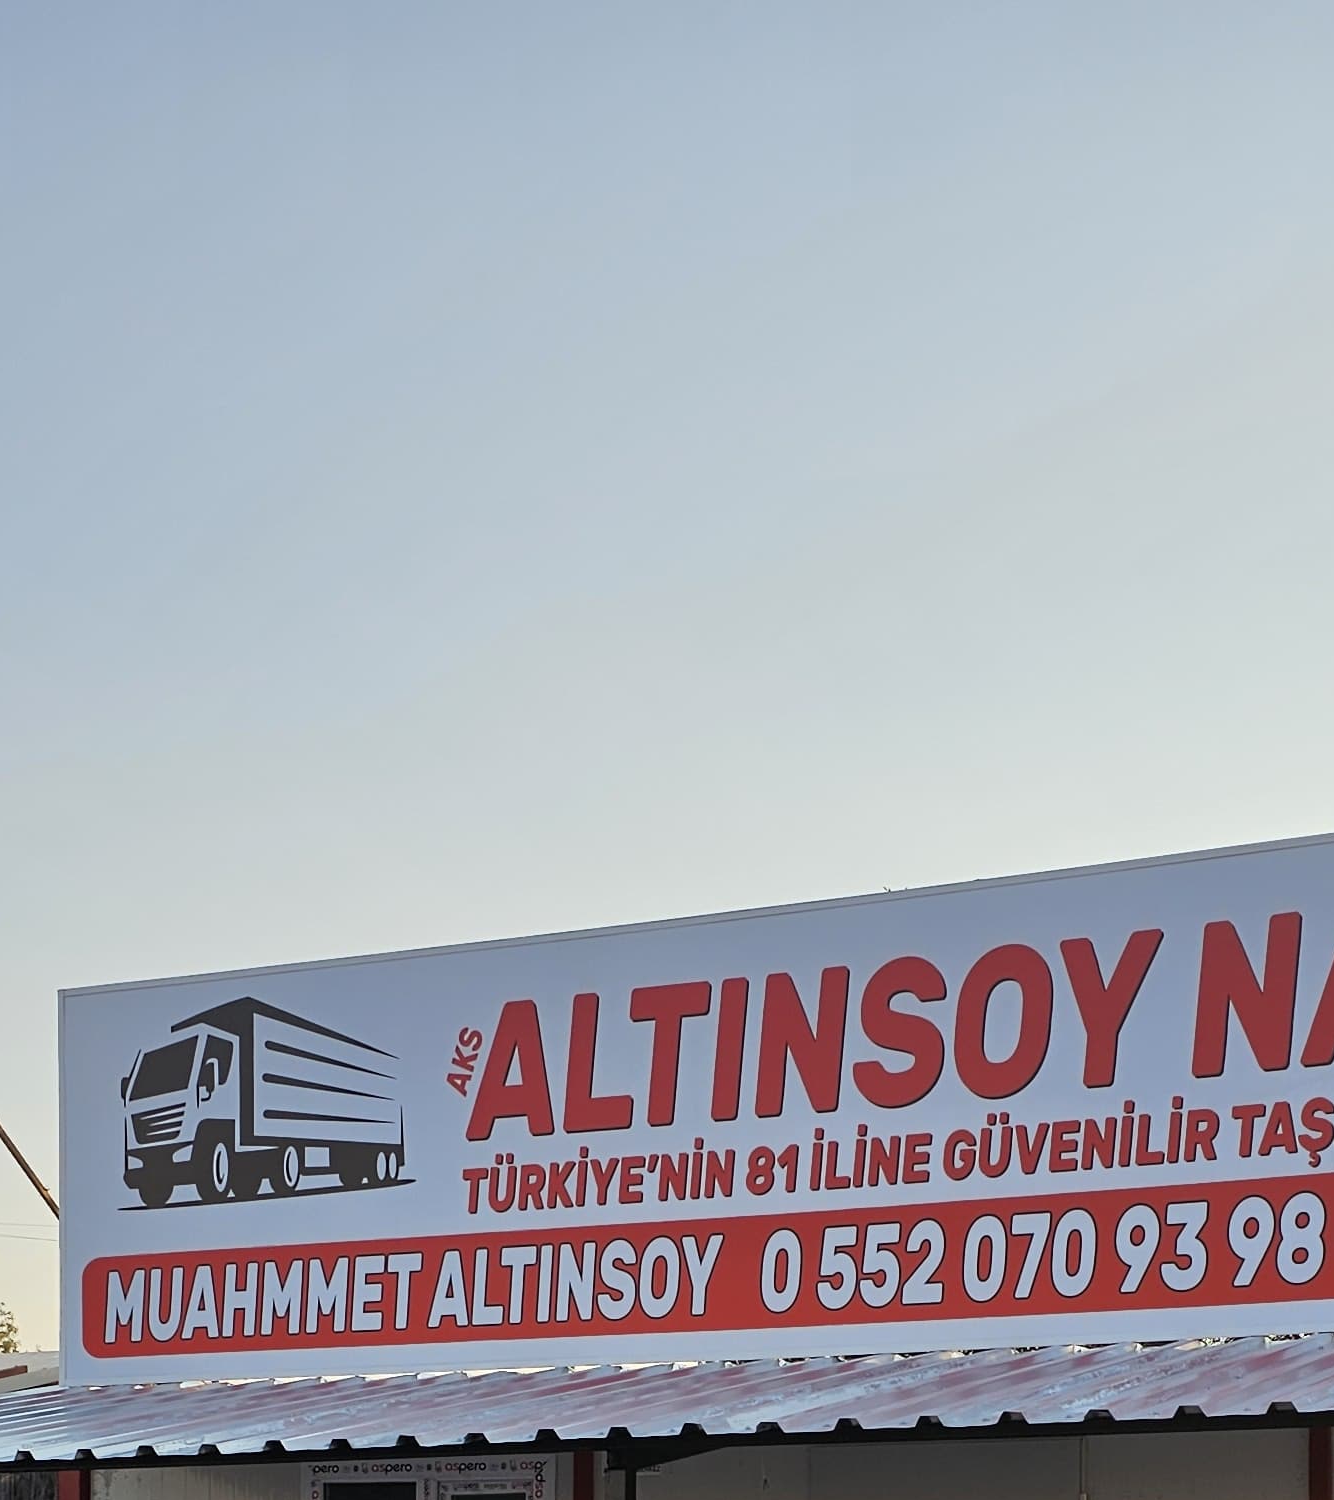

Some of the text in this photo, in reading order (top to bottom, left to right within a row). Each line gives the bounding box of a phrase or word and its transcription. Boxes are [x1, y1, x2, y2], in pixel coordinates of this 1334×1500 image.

[446, 1026, 483, 1097] AKS
[465, 928, 1164, 1142] ALTINSOY
[463, 1137, 740, 1215] TÜRKİYE'NİN
[744, 1148, 798, 1196] 81
[809, 1122, 934, 1191] İLİNE
[943, 1095, 1217, 1181] GÜVENİLİR
[104, 1250, 422, 1344] MUAHMMET
[427, 1233, 725, 1329] ALTINSOY
[759, 1228, 803, 1313] 0
[815, 1219, 947, 1310] 552
[962, 1207, 1097, 1303] 070
[1113, 1200, 1211, 1295] 93
[1227, 1190, 1327, 1288] 98
[445, 1462, 487, 1475] aspero
